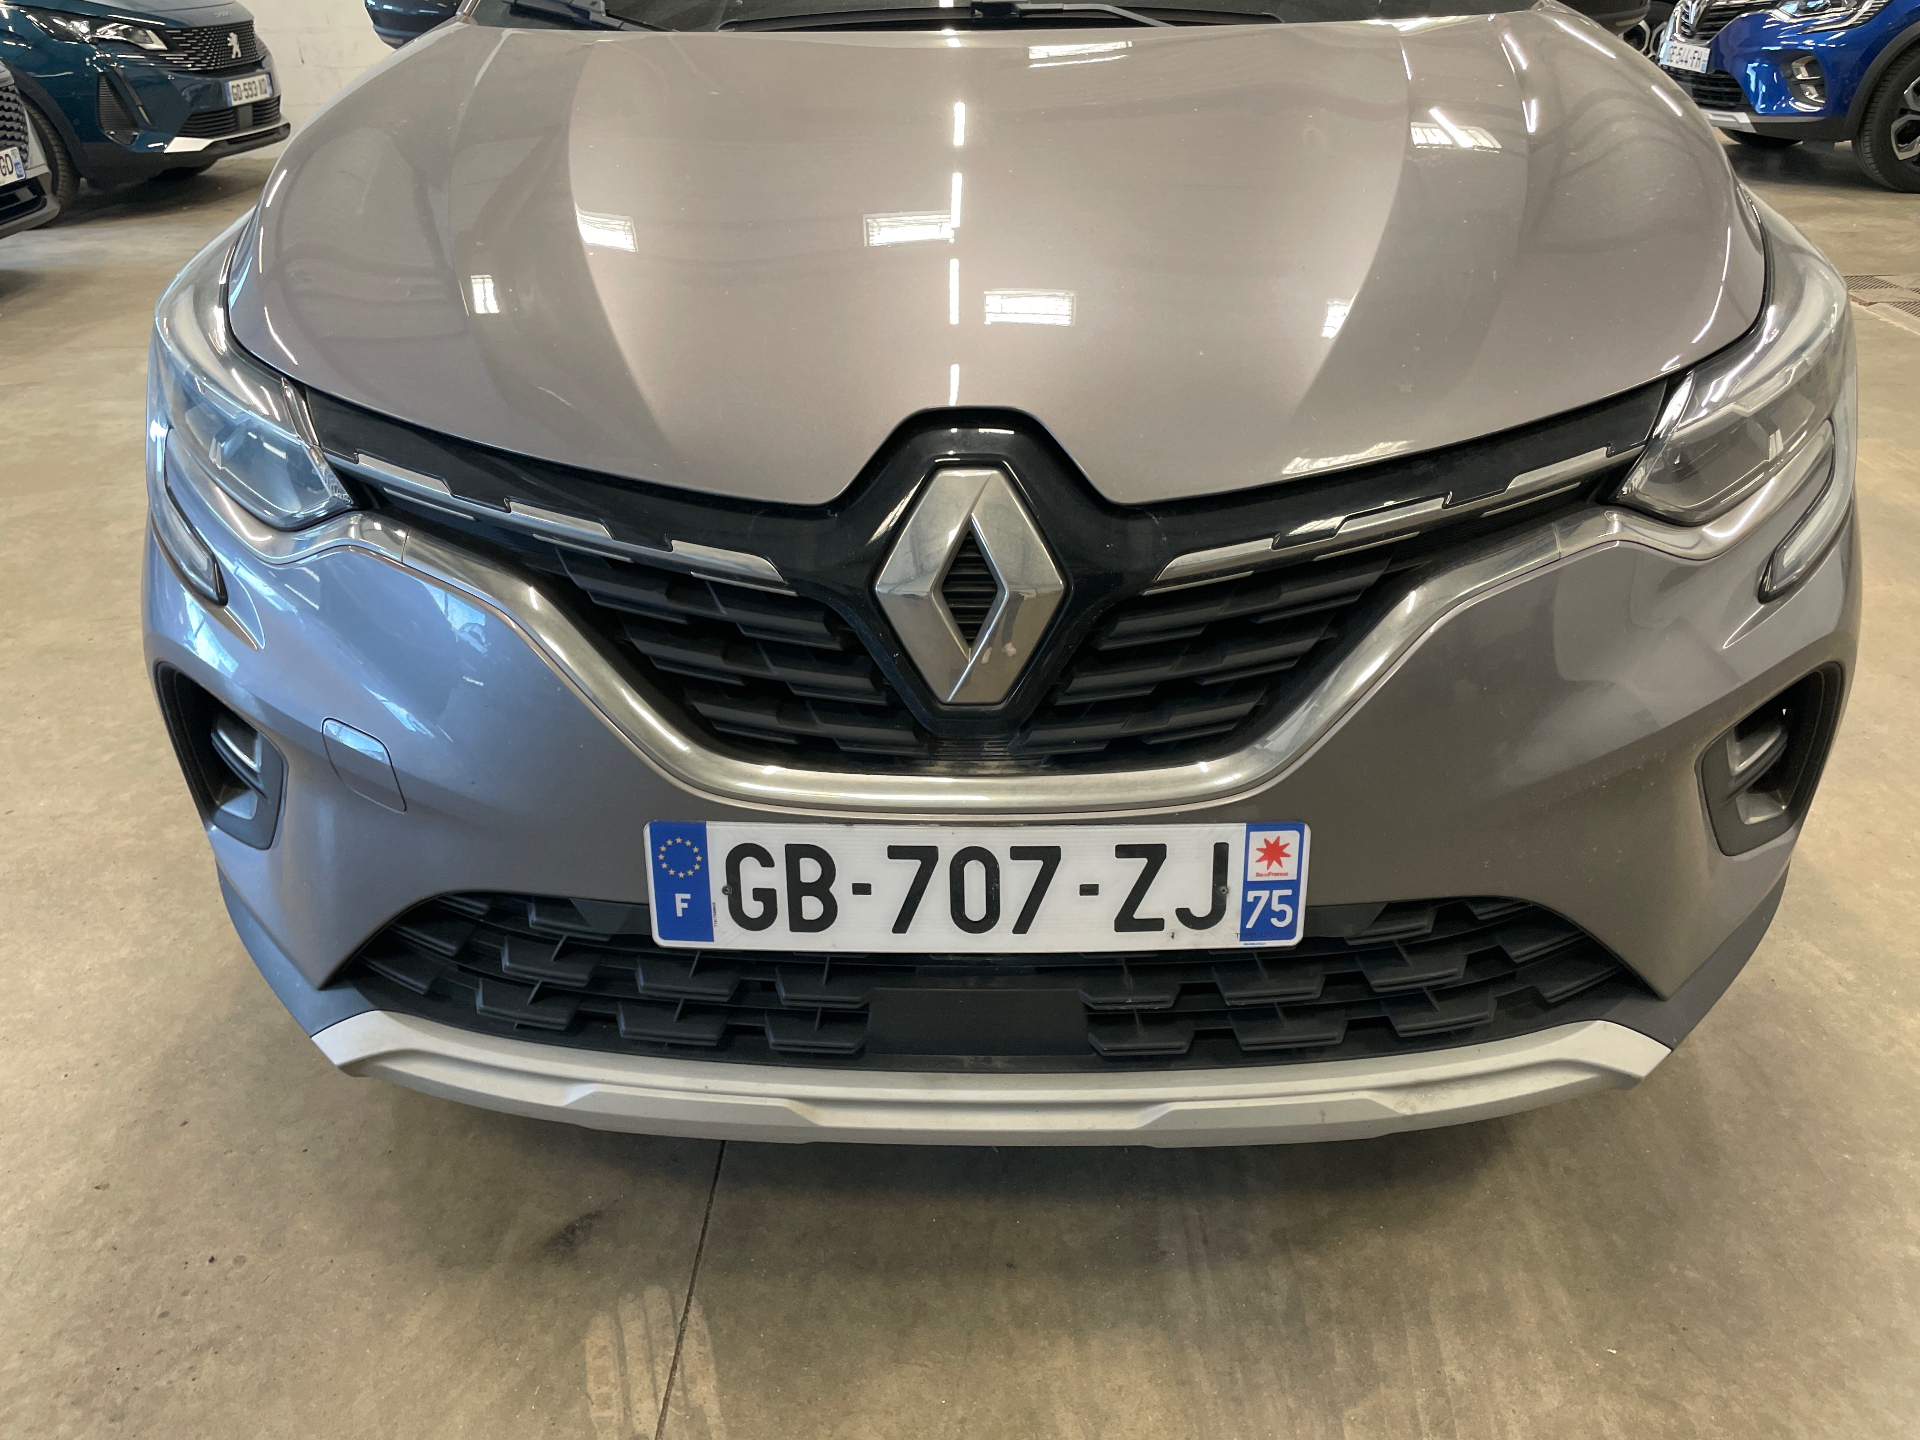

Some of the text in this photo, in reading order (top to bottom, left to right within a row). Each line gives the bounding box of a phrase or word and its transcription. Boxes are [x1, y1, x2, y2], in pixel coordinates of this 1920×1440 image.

[674, 893, 692, 918] F
[724, 841, 1230, 935] GB-707-ZJ
[1245, 889, 1294, 929] 75
